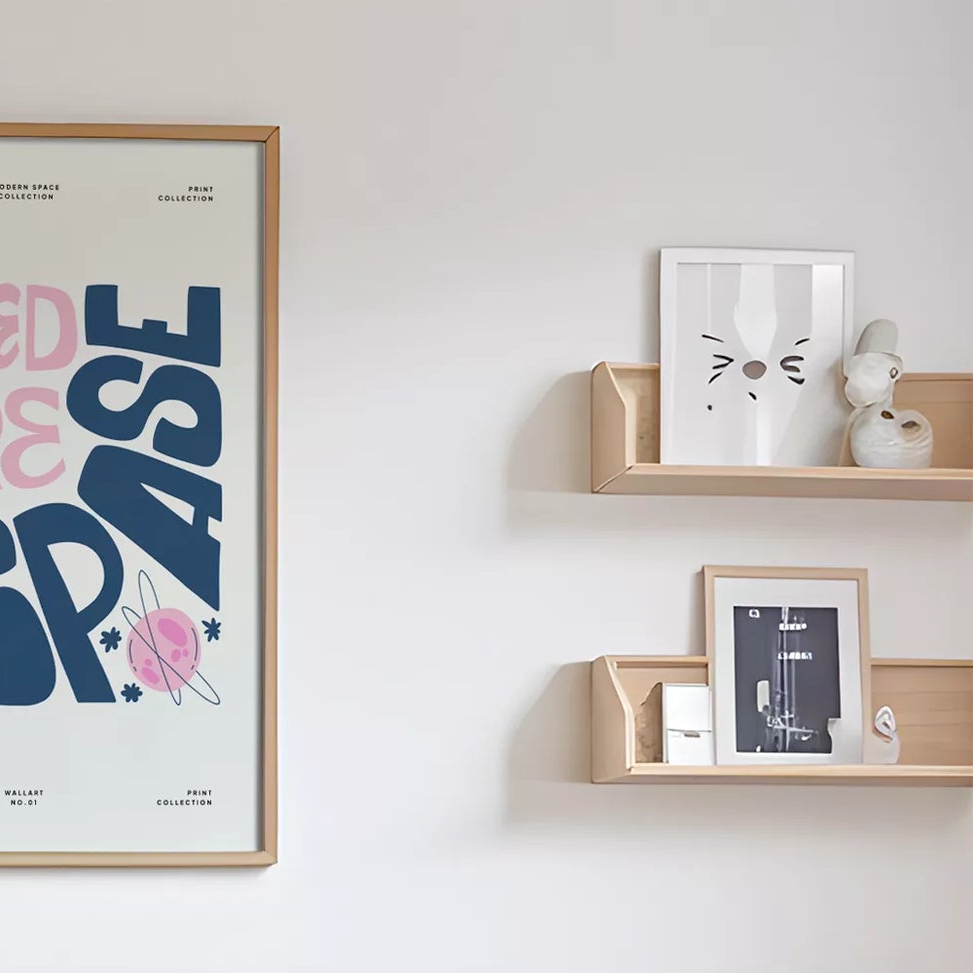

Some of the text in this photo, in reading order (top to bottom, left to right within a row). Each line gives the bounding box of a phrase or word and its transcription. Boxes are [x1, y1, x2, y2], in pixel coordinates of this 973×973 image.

[31, 183, 60, 192] SPACE
[187, 185, 214, 194] PRINT
[157, 194, 215, 203] COLLECTION
[3, 789, 44, 797] WALLART
[186, 789, 213, 797] PRINT
[9, 798, 38, 807] NO.01
[155, 798, 213, 807] COLLECTION
